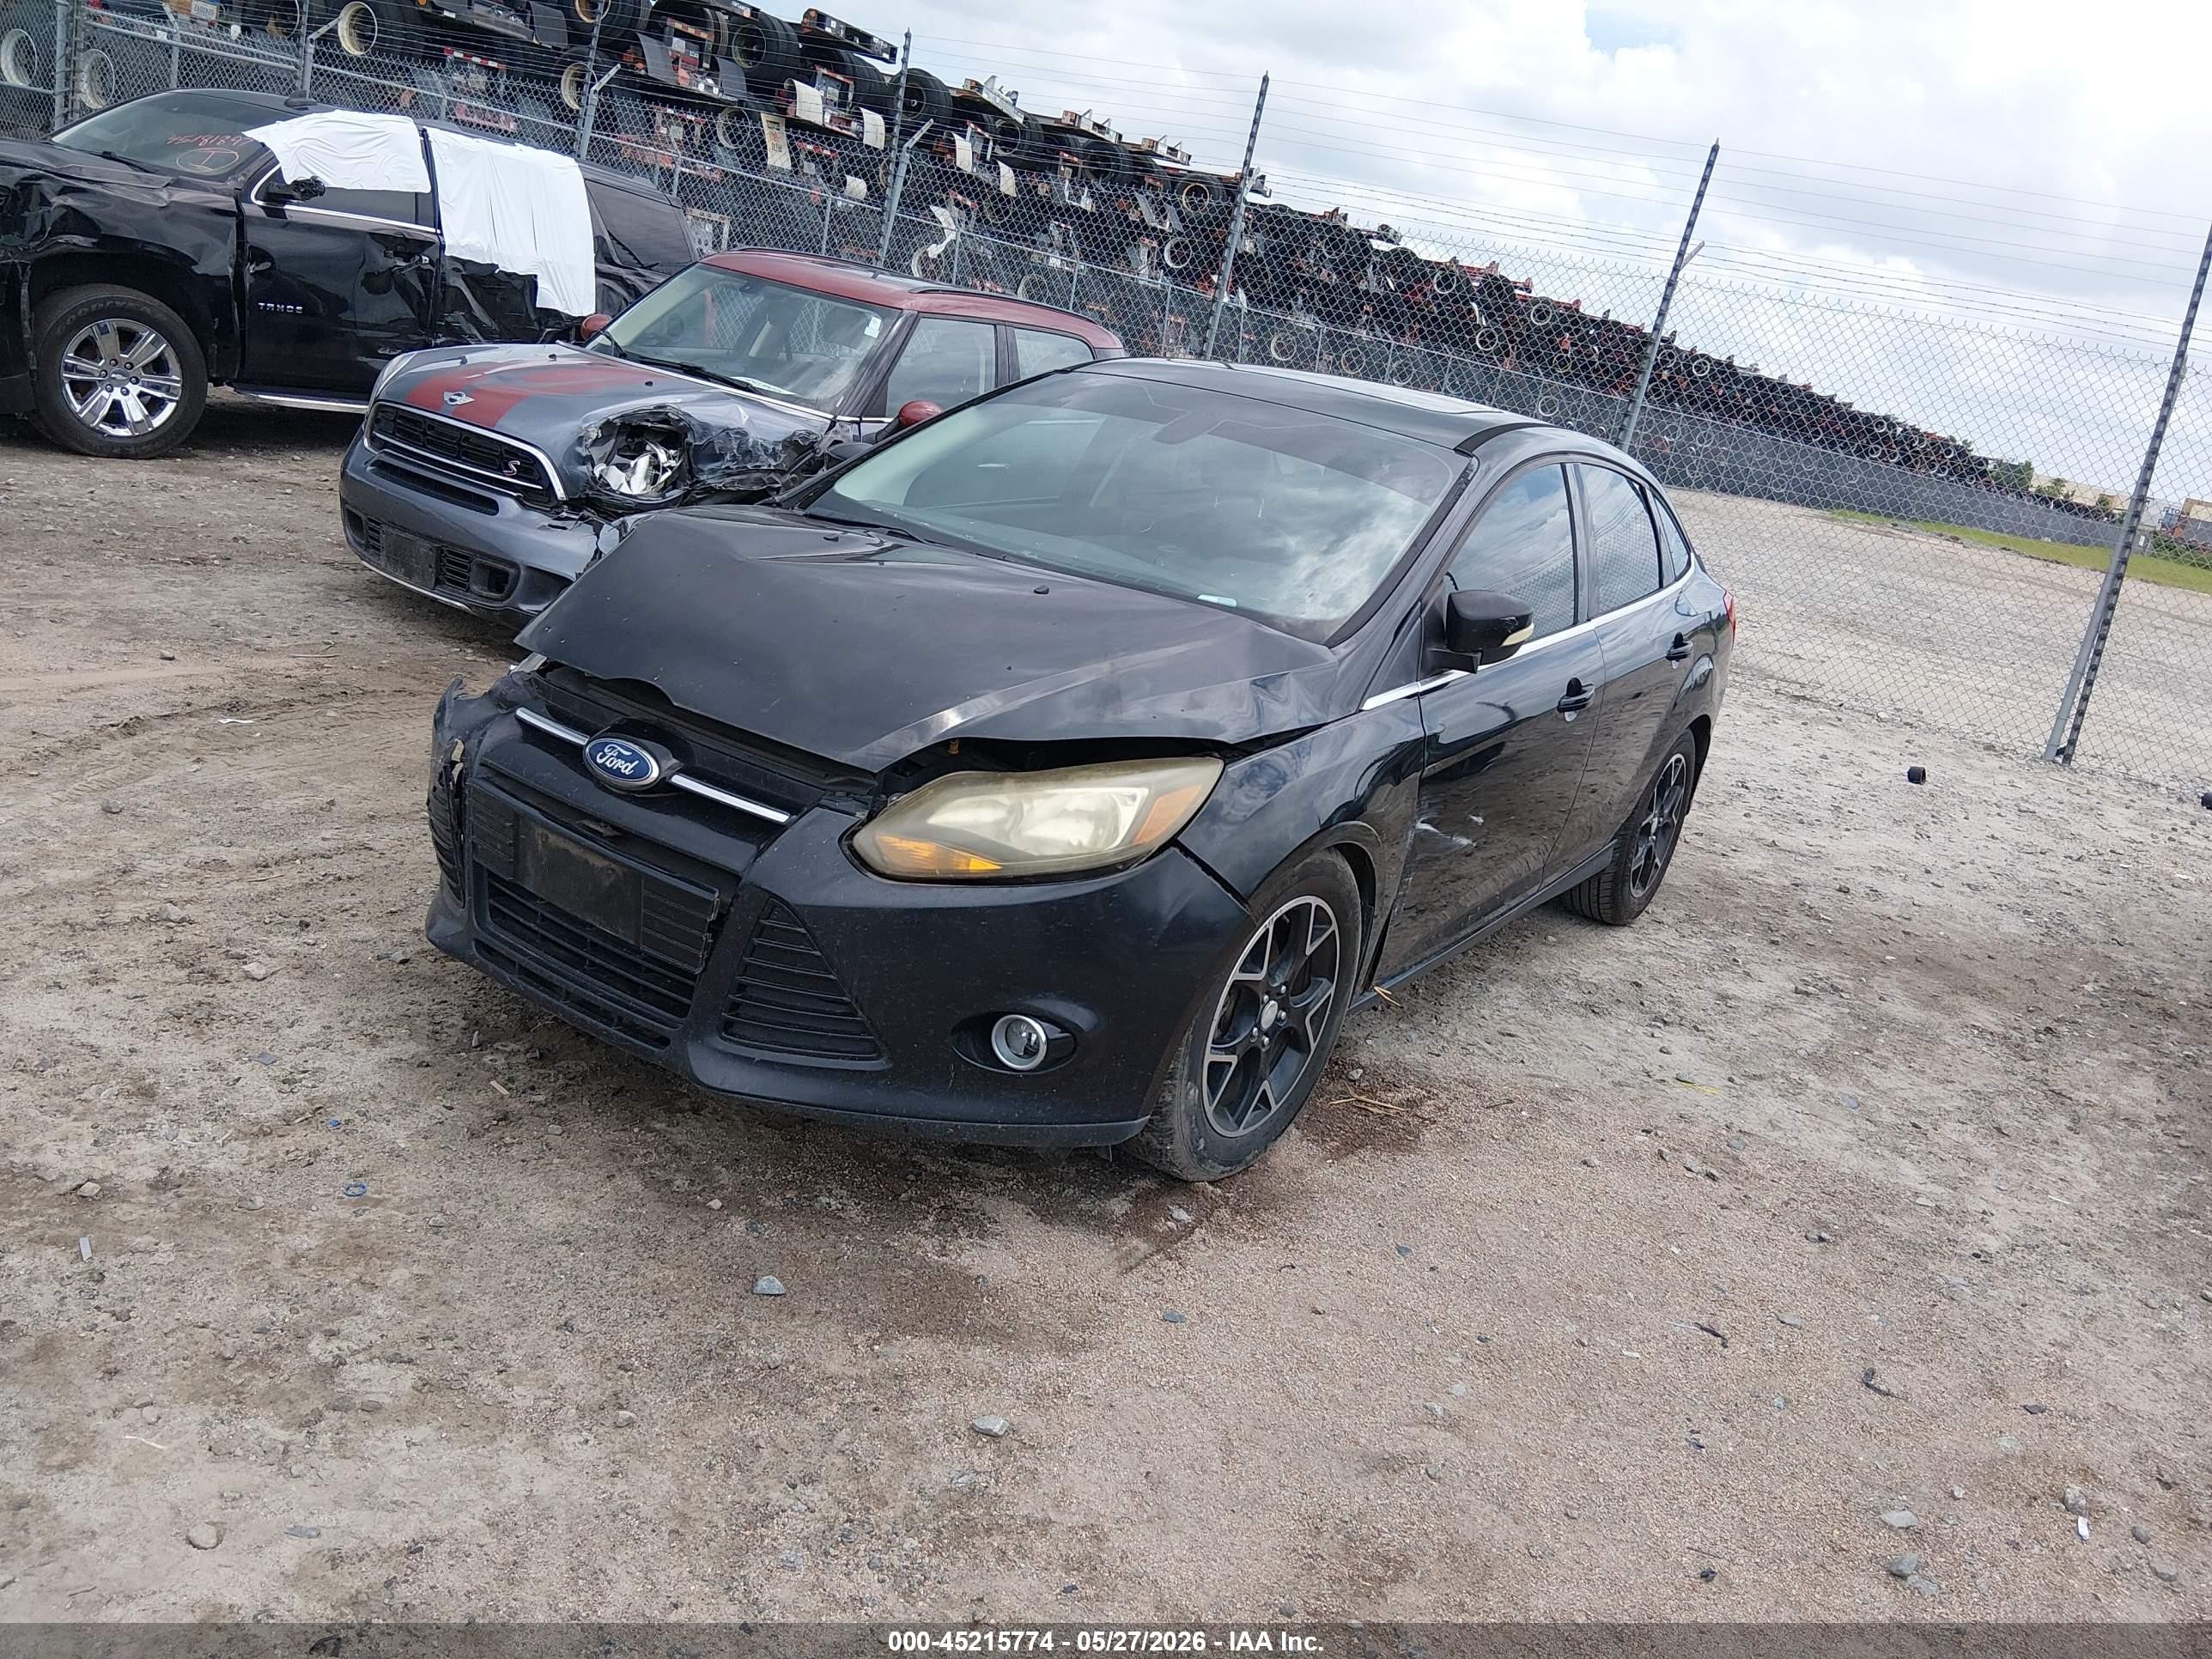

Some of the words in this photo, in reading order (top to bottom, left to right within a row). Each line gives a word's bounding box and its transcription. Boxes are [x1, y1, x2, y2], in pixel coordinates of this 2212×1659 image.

[258, 302, 303, 314] TAHOE
[502, 460, 520, 477] S
[596, 744, 640, 775] Ford
